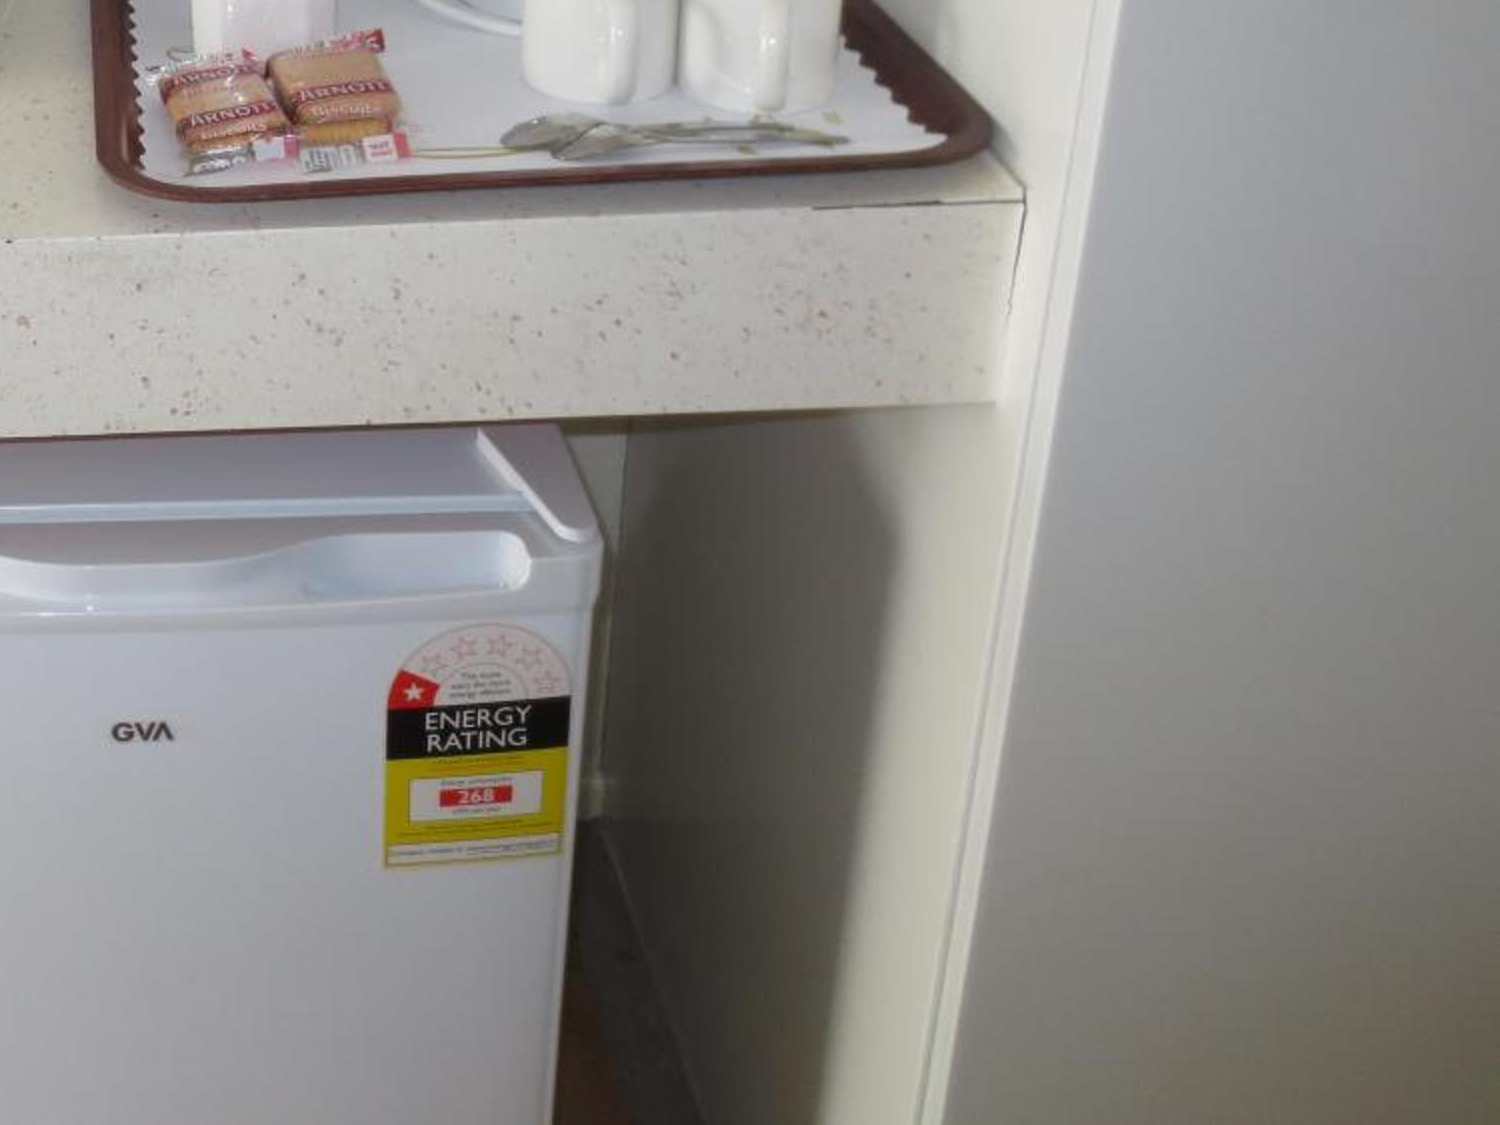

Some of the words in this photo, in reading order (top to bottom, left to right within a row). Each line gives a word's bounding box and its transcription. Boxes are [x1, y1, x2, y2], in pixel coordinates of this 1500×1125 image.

[425, 704, 532, 731] ENERGY
[111, 721, 175, 742] GVA
[426, 727, 527, 753] RATING
[456, 787, 495, 804] 268
